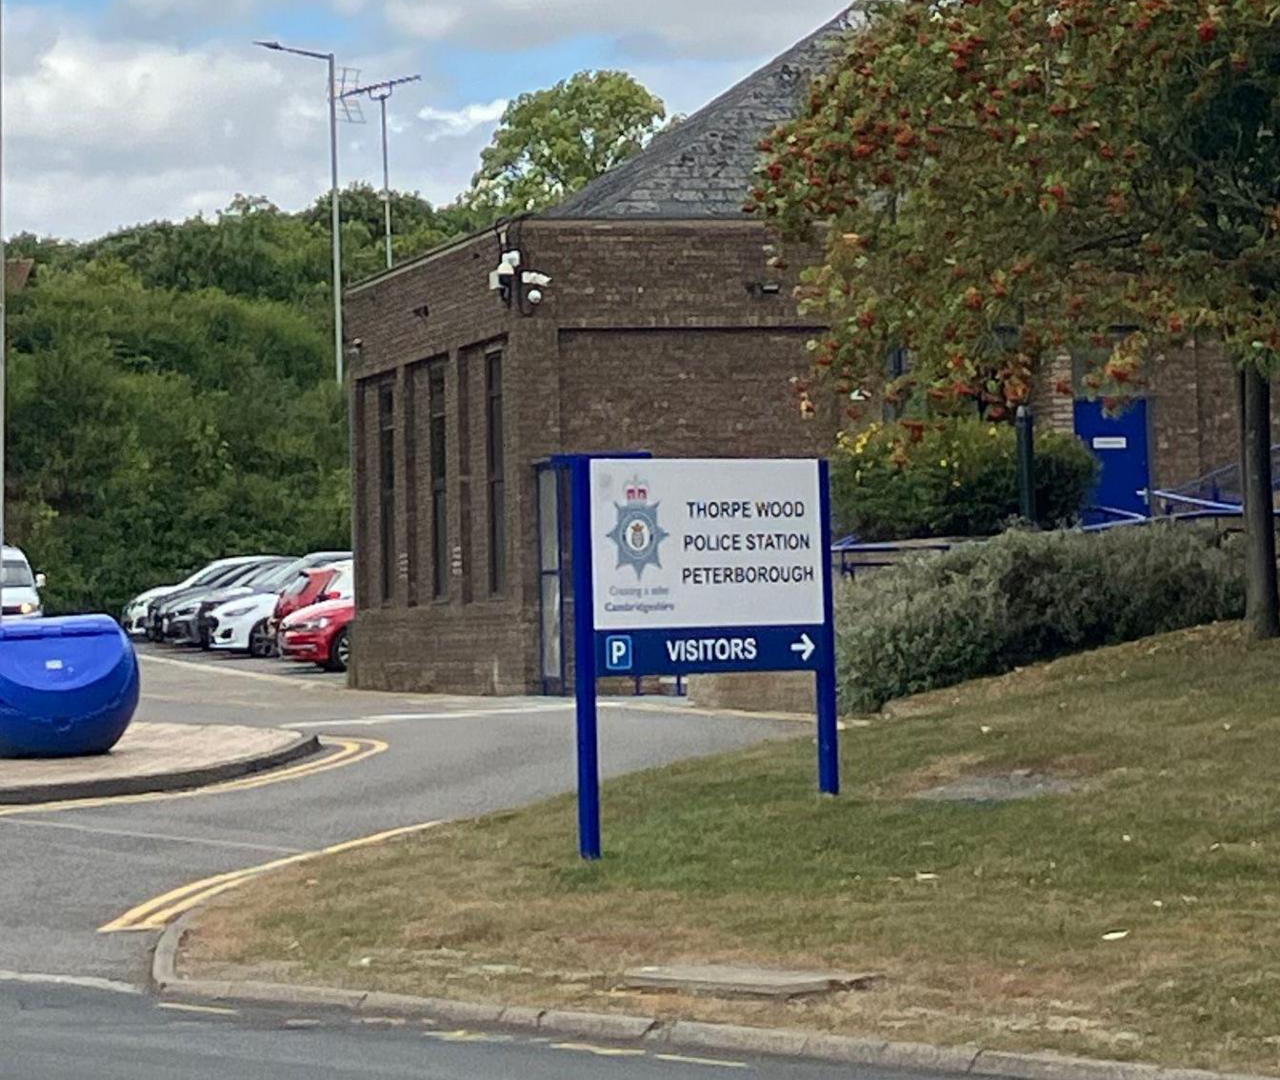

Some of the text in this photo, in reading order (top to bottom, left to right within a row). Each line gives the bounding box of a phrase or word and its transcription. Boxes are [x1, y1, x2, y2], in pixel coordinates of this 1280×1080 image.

[686, 501, 805, 518] THORPE WOOD
[683, 533, 810, 551] POLICE STATION
[682, 565, 814, 584] PETERBOROUGH
[611, 638, 757, 664] P VISITORS
